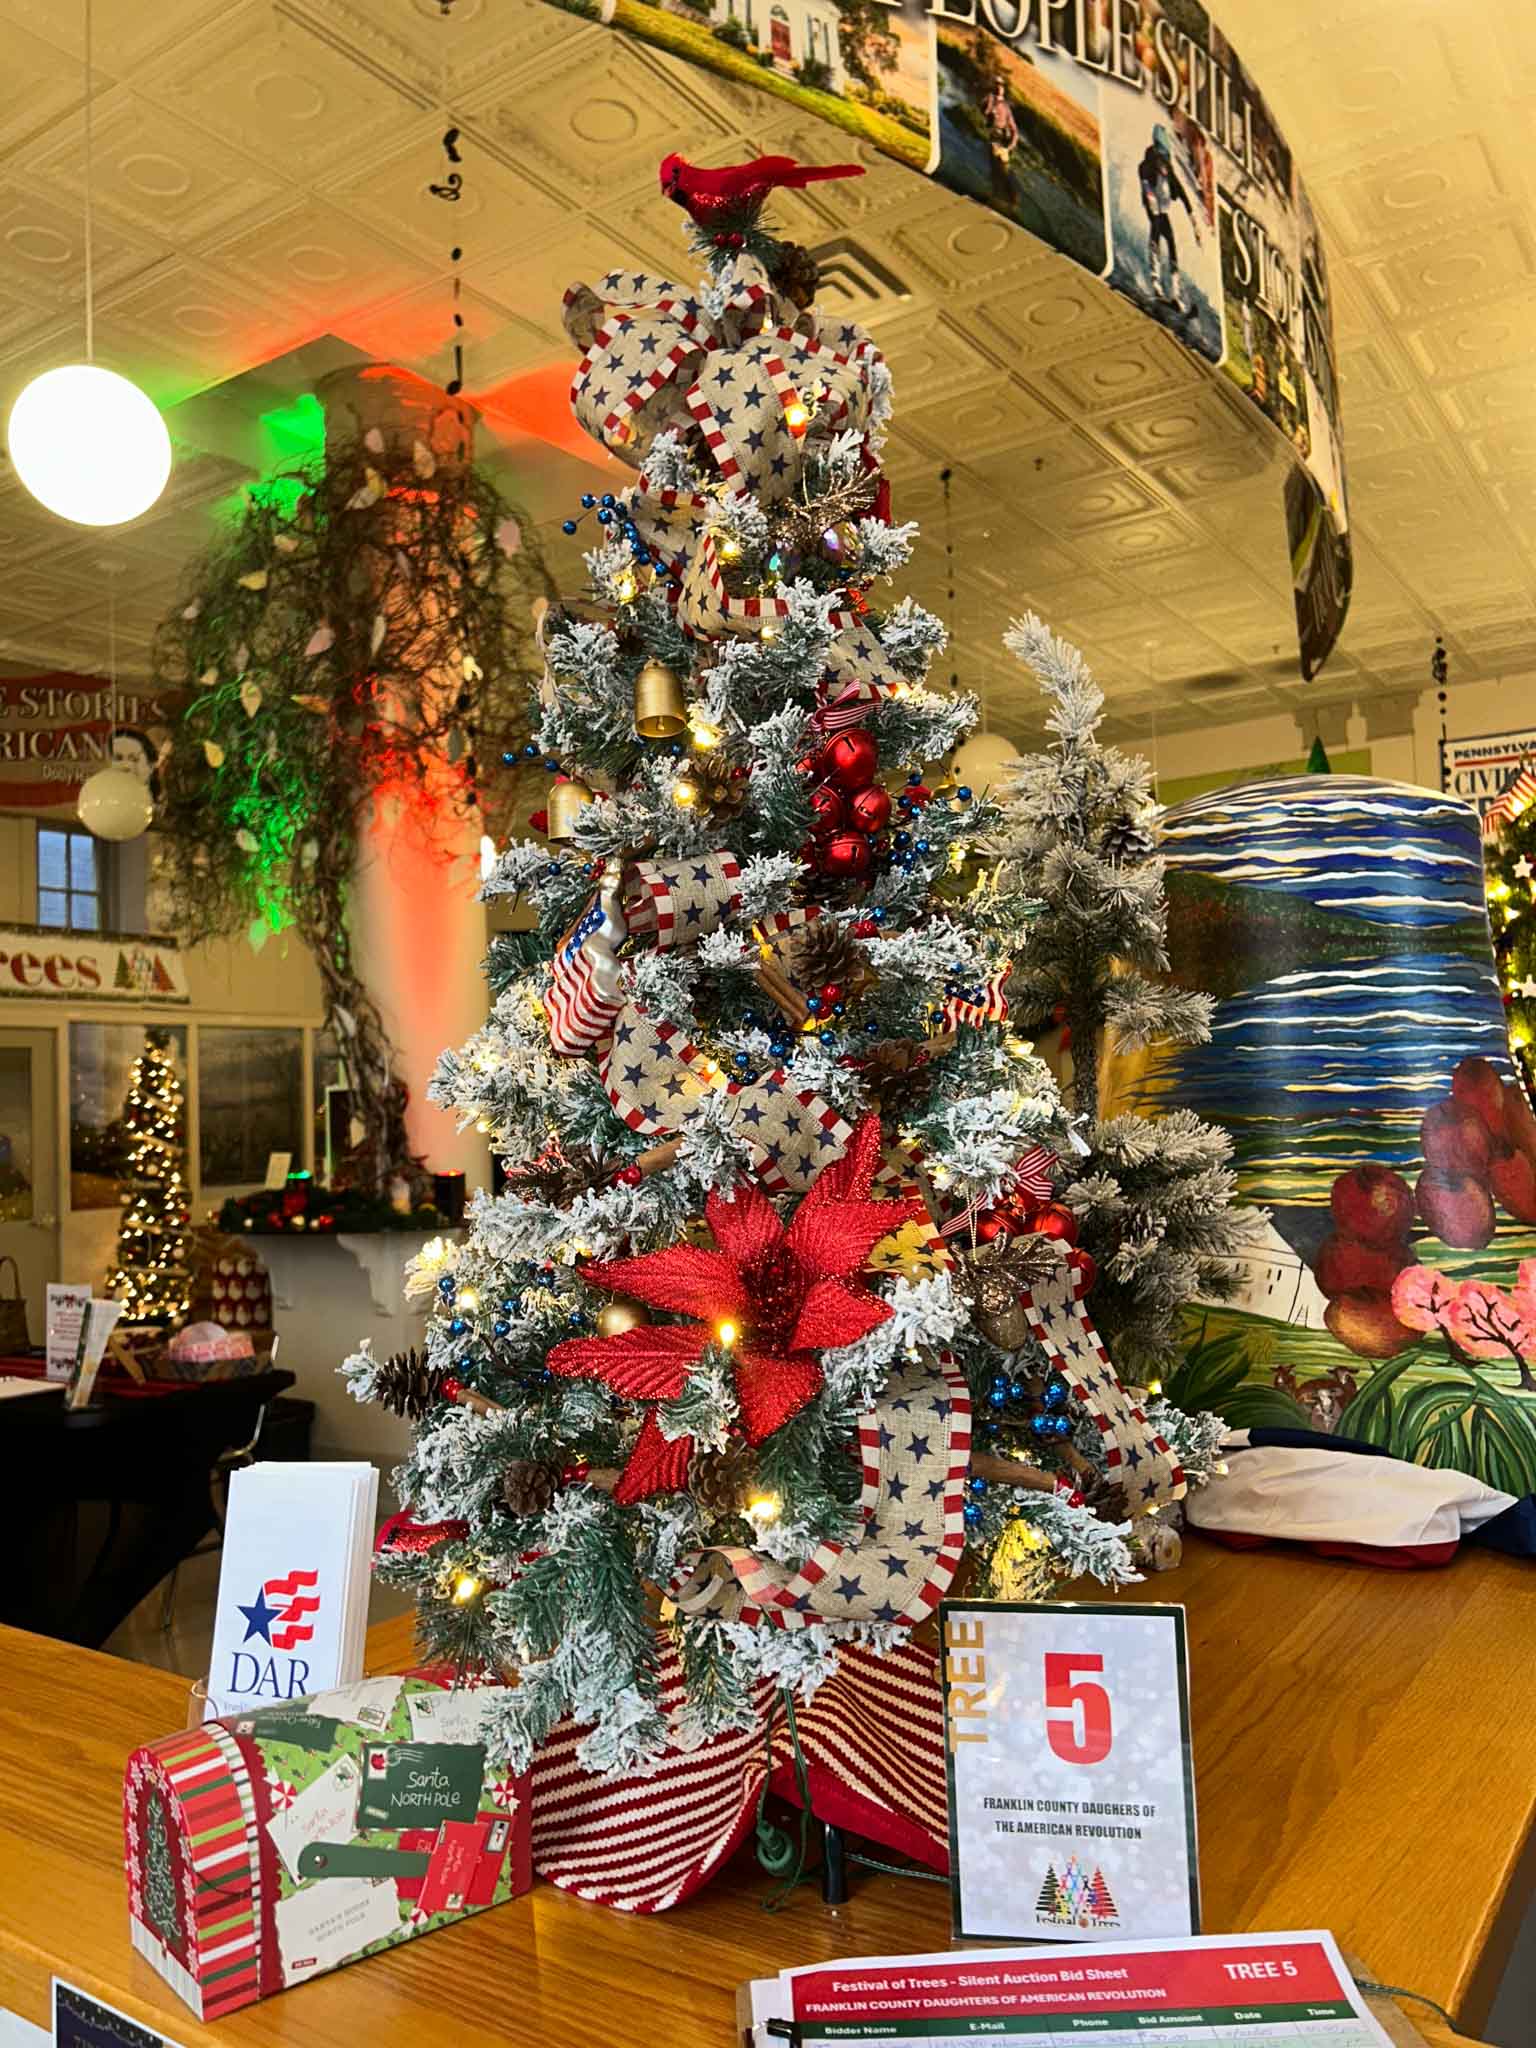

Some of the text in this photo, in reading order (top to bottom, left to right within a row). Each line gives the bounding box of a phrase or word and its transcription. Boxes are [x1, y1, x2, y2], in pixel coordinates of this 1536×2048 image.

[226, 1651, 311, 1700] DAR
[944, 1620, 989, 1753] TREE
[1044, 1652, 1113, 1765] 5
[407, 1767, 451, 1789] Santa
[391, 1792, 434, 1807] NORTH
[983, 1797, 1156, 1817] FRANKLIN COUNTY DAUGHERS OF
[995, 1820, 1142, 1839] THE AMERICAN REVOLUTION
[1091, 1916, 1121, 1928] Trees
[832, 1979, 889, 1993] Festival
[891, 1980, 907, 1991] of
[908, 1978, 948, 1989] Trees
[958, 1974, 1001, 1987] Silent
[1003, 1971, 1057, 1984] Auction
[1060, 1969, 1085, 1983] Bid
[1087, 1967, 1128, 1980] Sheet
[1223, 1960, 1298, 1981] TREE 5
[805, 1987, 1167, 2013] FRANKLIN COUNTY DAUGHTERS OF AMERICAN REVOLUTION
[1138, 2013, 1203, 2025] Bid Amount
[1234, 2010, 1263, 2020] Date
[1306, 2007, 1337, 2017] Time
[864, 2025, 897, 2034] Name
[969, 2021, 1005, 2031] E-Mail
[1072, 2018, 1109, 2028] Phone
